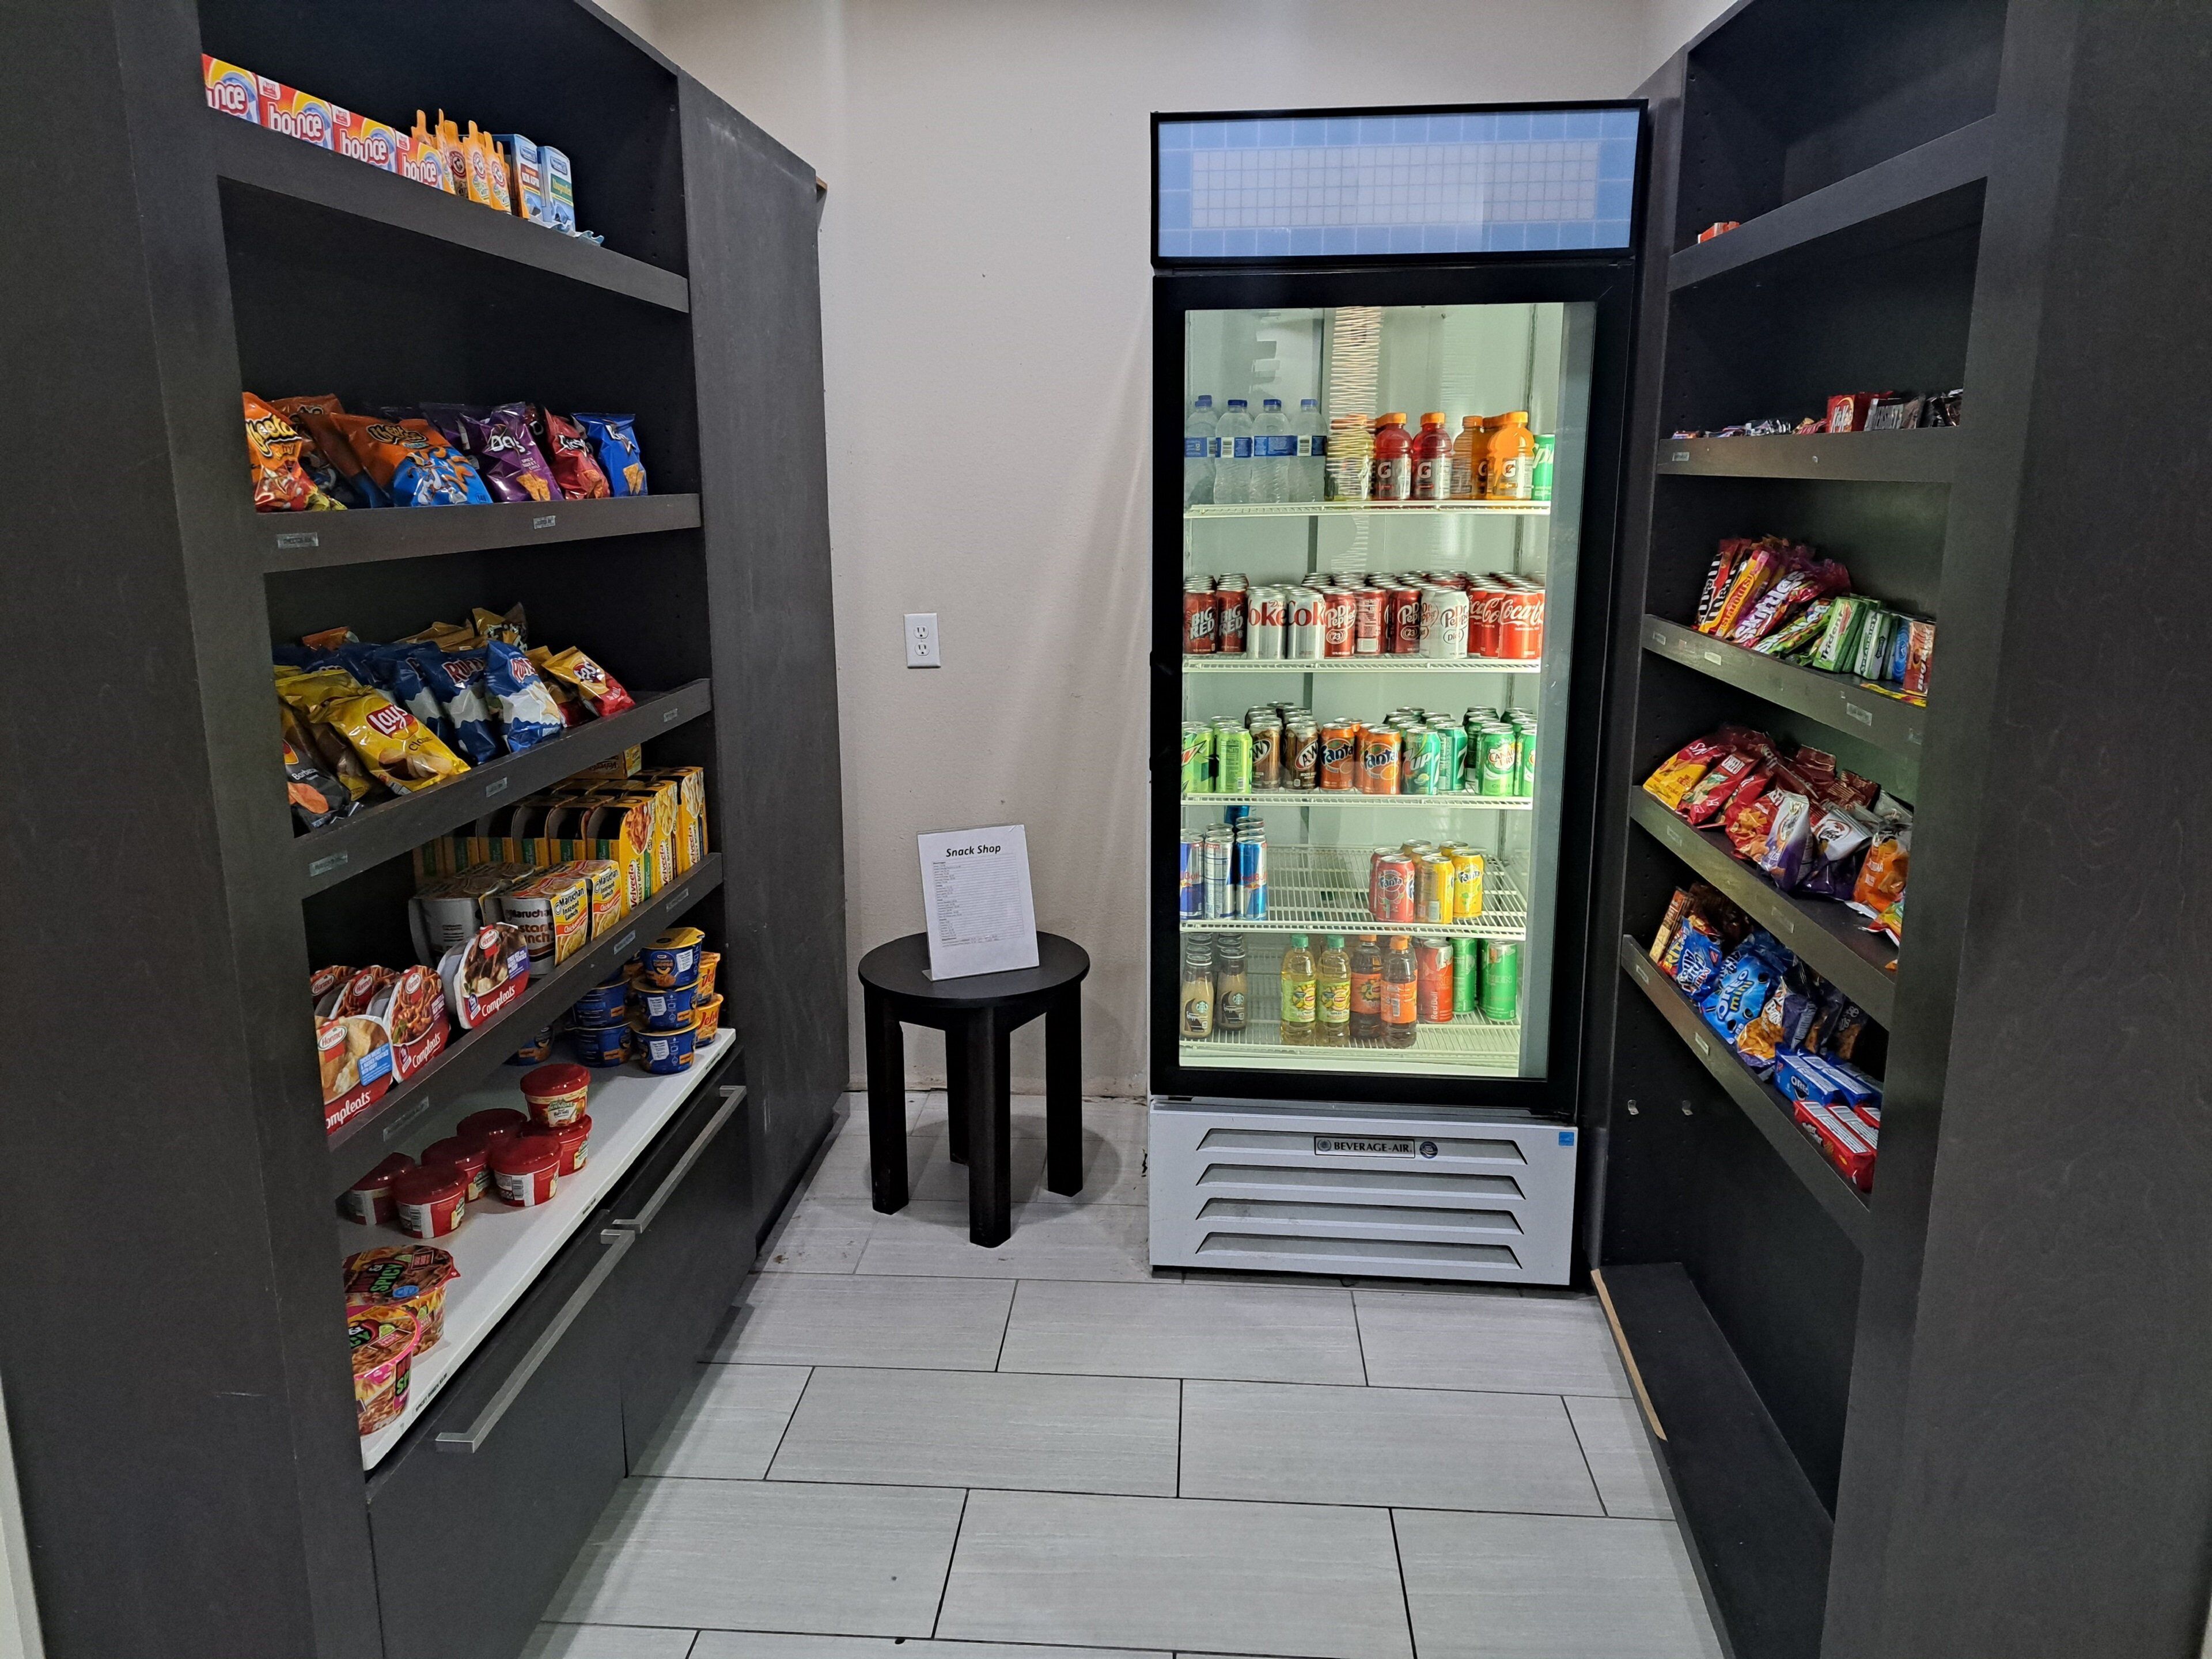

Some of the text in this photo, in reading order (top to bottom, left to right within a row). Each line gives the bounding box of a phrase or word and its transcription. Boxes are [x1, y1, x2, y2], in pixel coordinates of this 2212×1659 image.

[270, 105, 321, 138] bounce
[342, 131, 387, 162] bounce
[403, 154, 437, 183] bounce
[1377, 461, 1391, 478] G
[1418, 461, 1431, 478] G
[1502, 460, 1517, 478] G
[1192, 606, 1213, 625] BIG
[1219, 603, 1241, 623] BIG
[1248, 601, 1288, 627] oke
[1736, 571, 1805, 643] Skittles
[1190, 618, 1215, 641] RED
[1218, 616, 1244, 636] RED
[1332, 632, 1341, 641] 23
[1821, 611, 1844, 662] Trident
[1861, 614, 1877, 671] SPEARMINT
[1321, 744, 1354, 764] Fanta
[1364, 749, 1399, 771] Fanta
[946, 844, 1001, 857] Snack Shop
[599, 869, 619, 886] Maruchan
[628, 864, 638, 908] Velveeta
[1379, 877, 1403, 888] Fanta
[1458, 870, 1480, 883] Fanta
[559, 887, 585, 907] Maruchan
[600, 882, 615, 893] Instant
[602, 889, 613, 900] Lunch
[562, 901, 579, 915] Instant
[565, 909, 579, 921] Lunch
[564, 919, 580, 933] Chicken
[313, 978, 335, 993] Hormel
[355, 979, 372, 993] Hormel
[408, 976, 421, 991] Hormel
[482, 985, 516, 1017] Compleats
[1717, 969, 1749, 1021] OREO
[1730, 981, 1754, 1012] mini
[321, 1030, 344, 1046] Hormel
[412, 1032, 441, 1069] Compleats
[1790, 1076, 1810, 1095] OREO
[1334, 1142, 1411, 1153] BEVERAGE-AIR
[370, 1264, 403, 1292] SPICY
